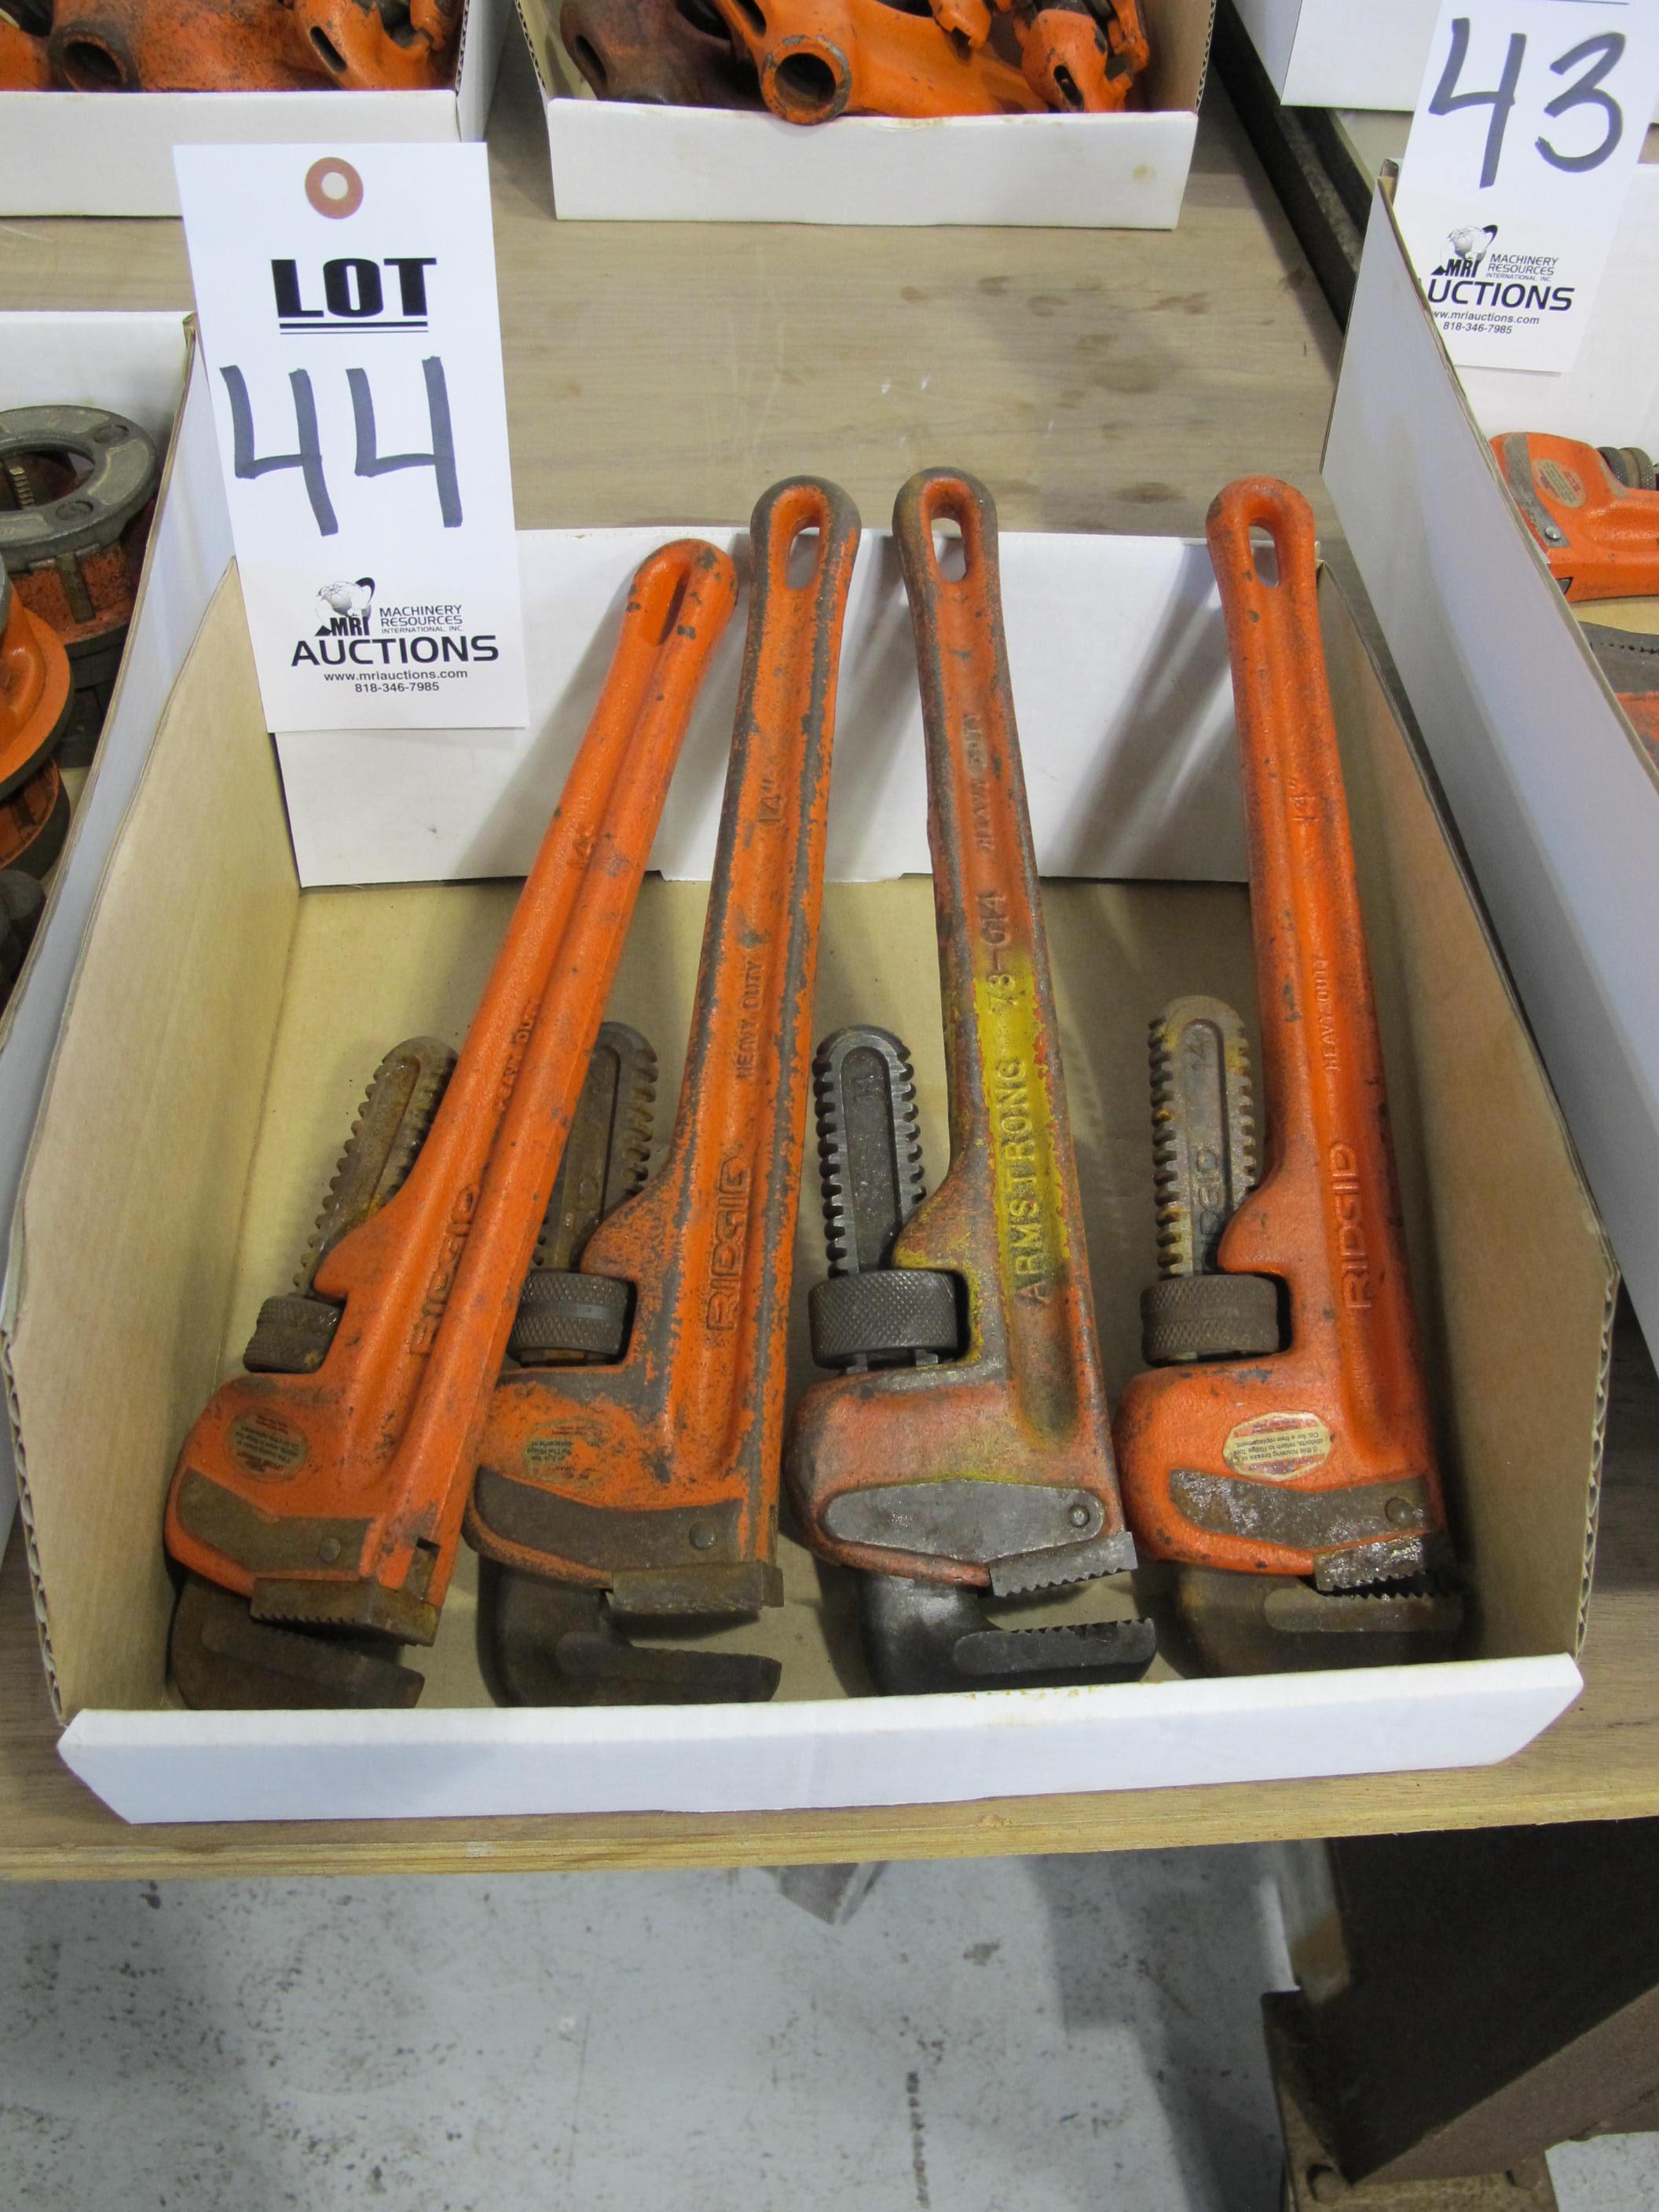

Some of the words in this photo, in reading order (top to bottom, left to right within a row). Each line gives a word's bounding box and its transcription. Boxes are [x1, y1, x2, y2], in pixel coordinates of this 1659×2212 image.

[1428, 17, 1626, 189] 43
[1445, 258, 1479, 278] MRI
[1488, 263, 1555, 276] RESOURCES
[1490, 254, 1559, 266] MACHINERY
[271, 257, 437, 318] LOT
[1423, 278, 1575, 311] UCTIONS
[1443, 322, 1512, 335] 818-346-7985
[219, 356, 463, 537] 44
[331, 614, 370, 636] MRI
[379, 604, 462, 617] MACHINERY
[381, 615, 463, 627] RESOURCES
[291, 635, 499, 666] AUCTIONS
[324, 669, 467, 681] www.mriauctions.com
[355, 682, 440, 693] 818-346-7985
[742, 960, 764, 1013] DUTY
[736, 1018, 760, 1081] HEAVY
[1317, 1013, 1341, 1071] HEAVY
[995, 1057, 1051, 1309] ARMSTRONG
[1330, 1142, 1373, 1309] RIDGID
[707, 1155, 752, 1332] RIDGID
[409, 1181, 481, 1357] RIDGID
